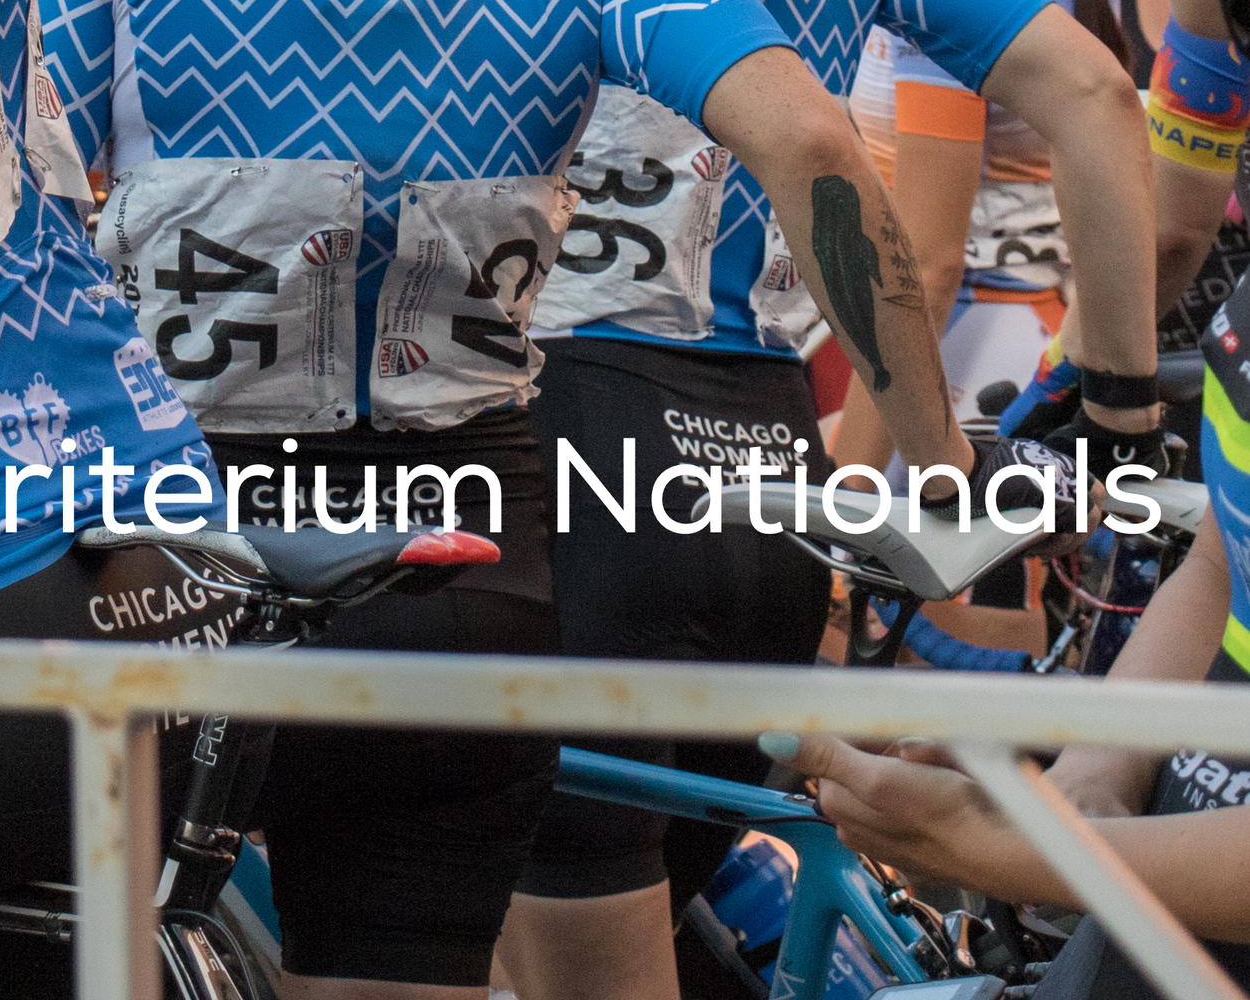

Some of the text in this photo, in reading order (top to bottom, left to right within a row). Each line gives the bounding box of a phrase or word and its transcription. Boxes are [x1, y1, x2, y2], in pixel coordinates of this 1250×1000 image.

[1148, 115, 1238, 161] NAPE
[555, 151, 675, 282] 36
[338, 232, 350, 260] USA
[154, 228, 280, 381] 45
[402, 297, 419, 333] NATIONAL
[316, 306, 328, 377] CHAMPIONSHIPS
[381, 341, 394, 375] USA
[327, 363, 336, 376] TTT
[0, 401, 60, 448] BFF
[143, 408, 169, 423] ATHLETE
[663, 408, 792, 445] CHICAGO
